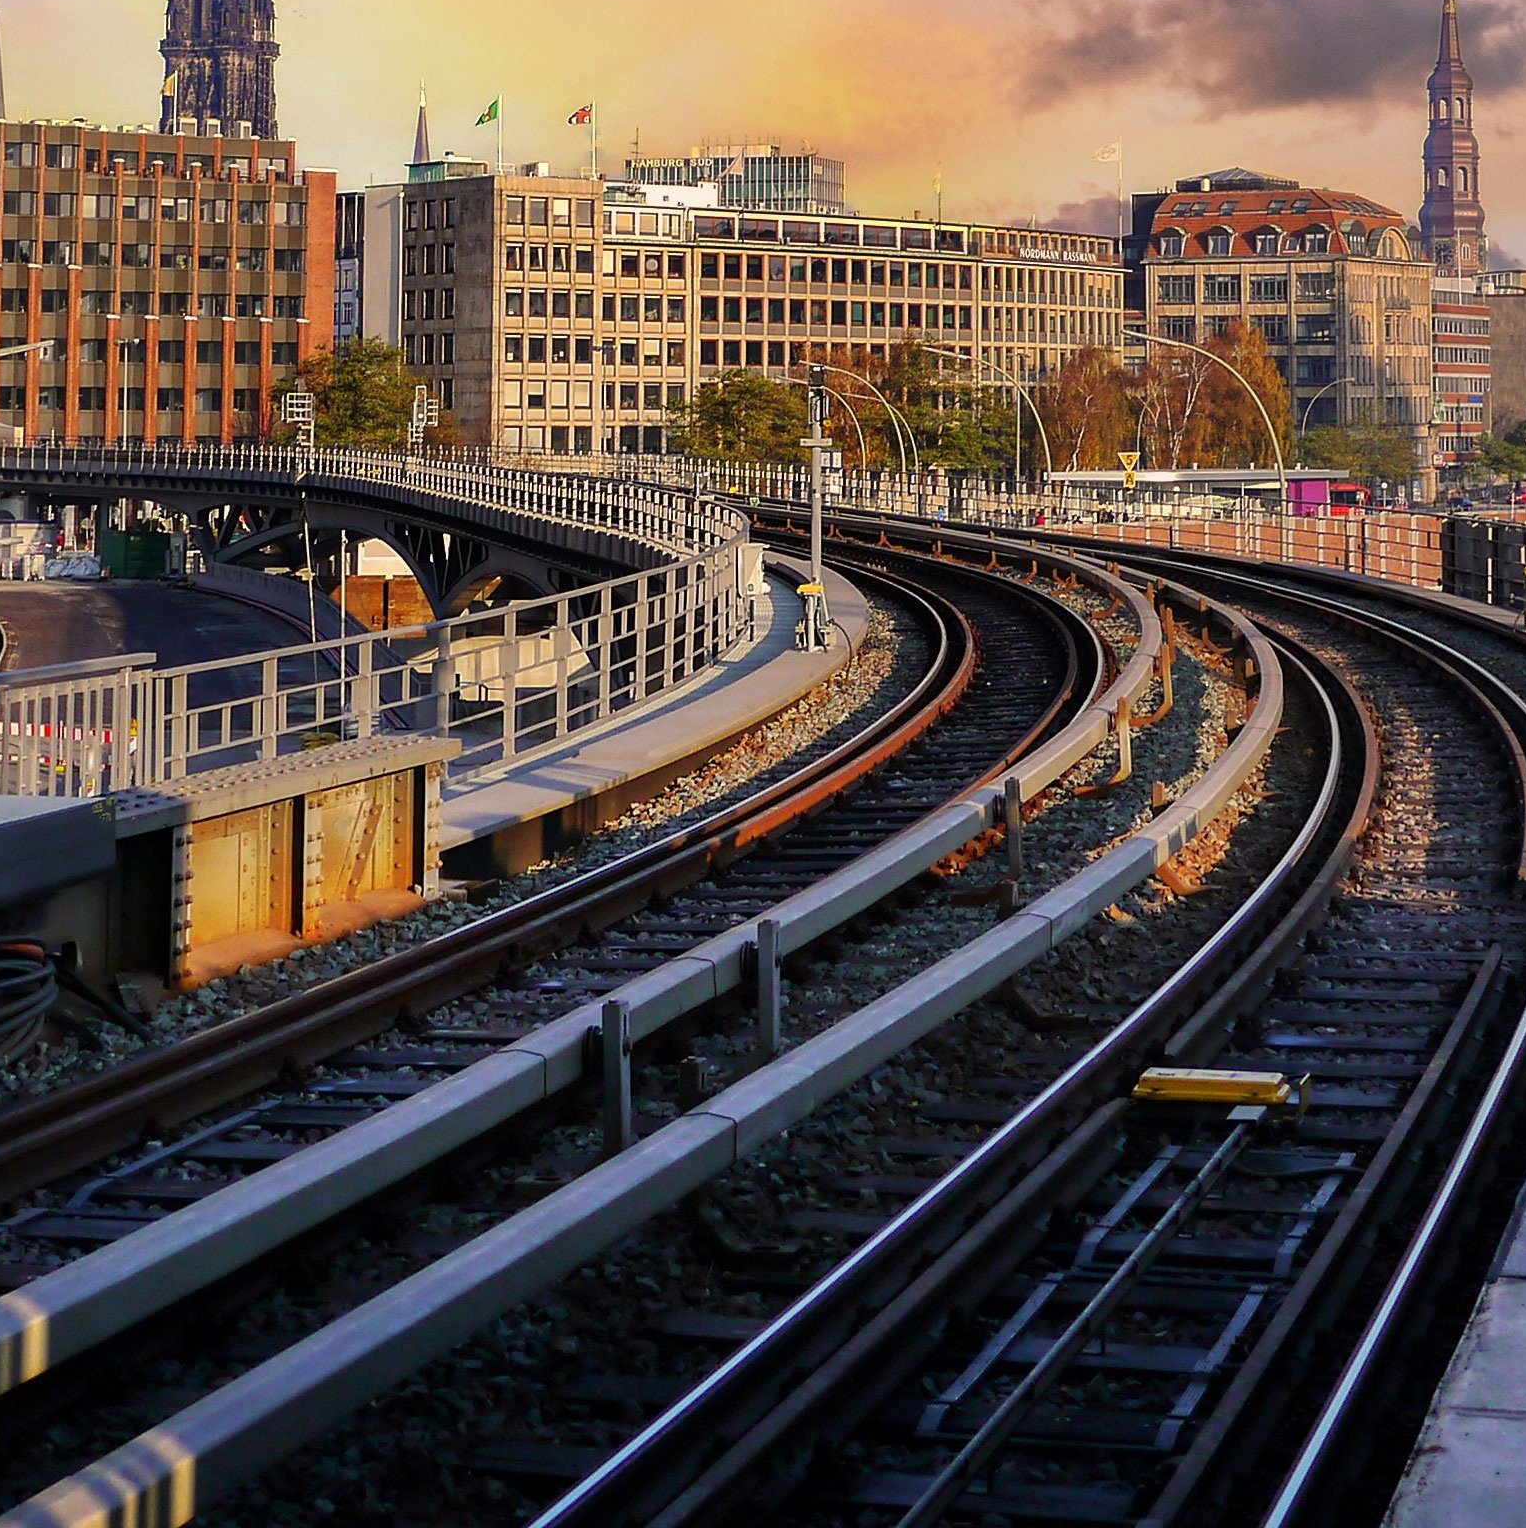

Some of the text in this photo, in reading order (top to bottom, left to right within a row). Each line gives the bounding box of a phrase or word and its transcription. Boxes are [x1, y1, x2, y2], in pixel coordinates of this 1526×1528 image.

[631, 159, 683, 168] HAMBURG
[1019, 248, 1097, 263] NORDMANN RASSMANN
[1125, 455, 1133, 465] 5
[1126, 472, 1134, 485] A
